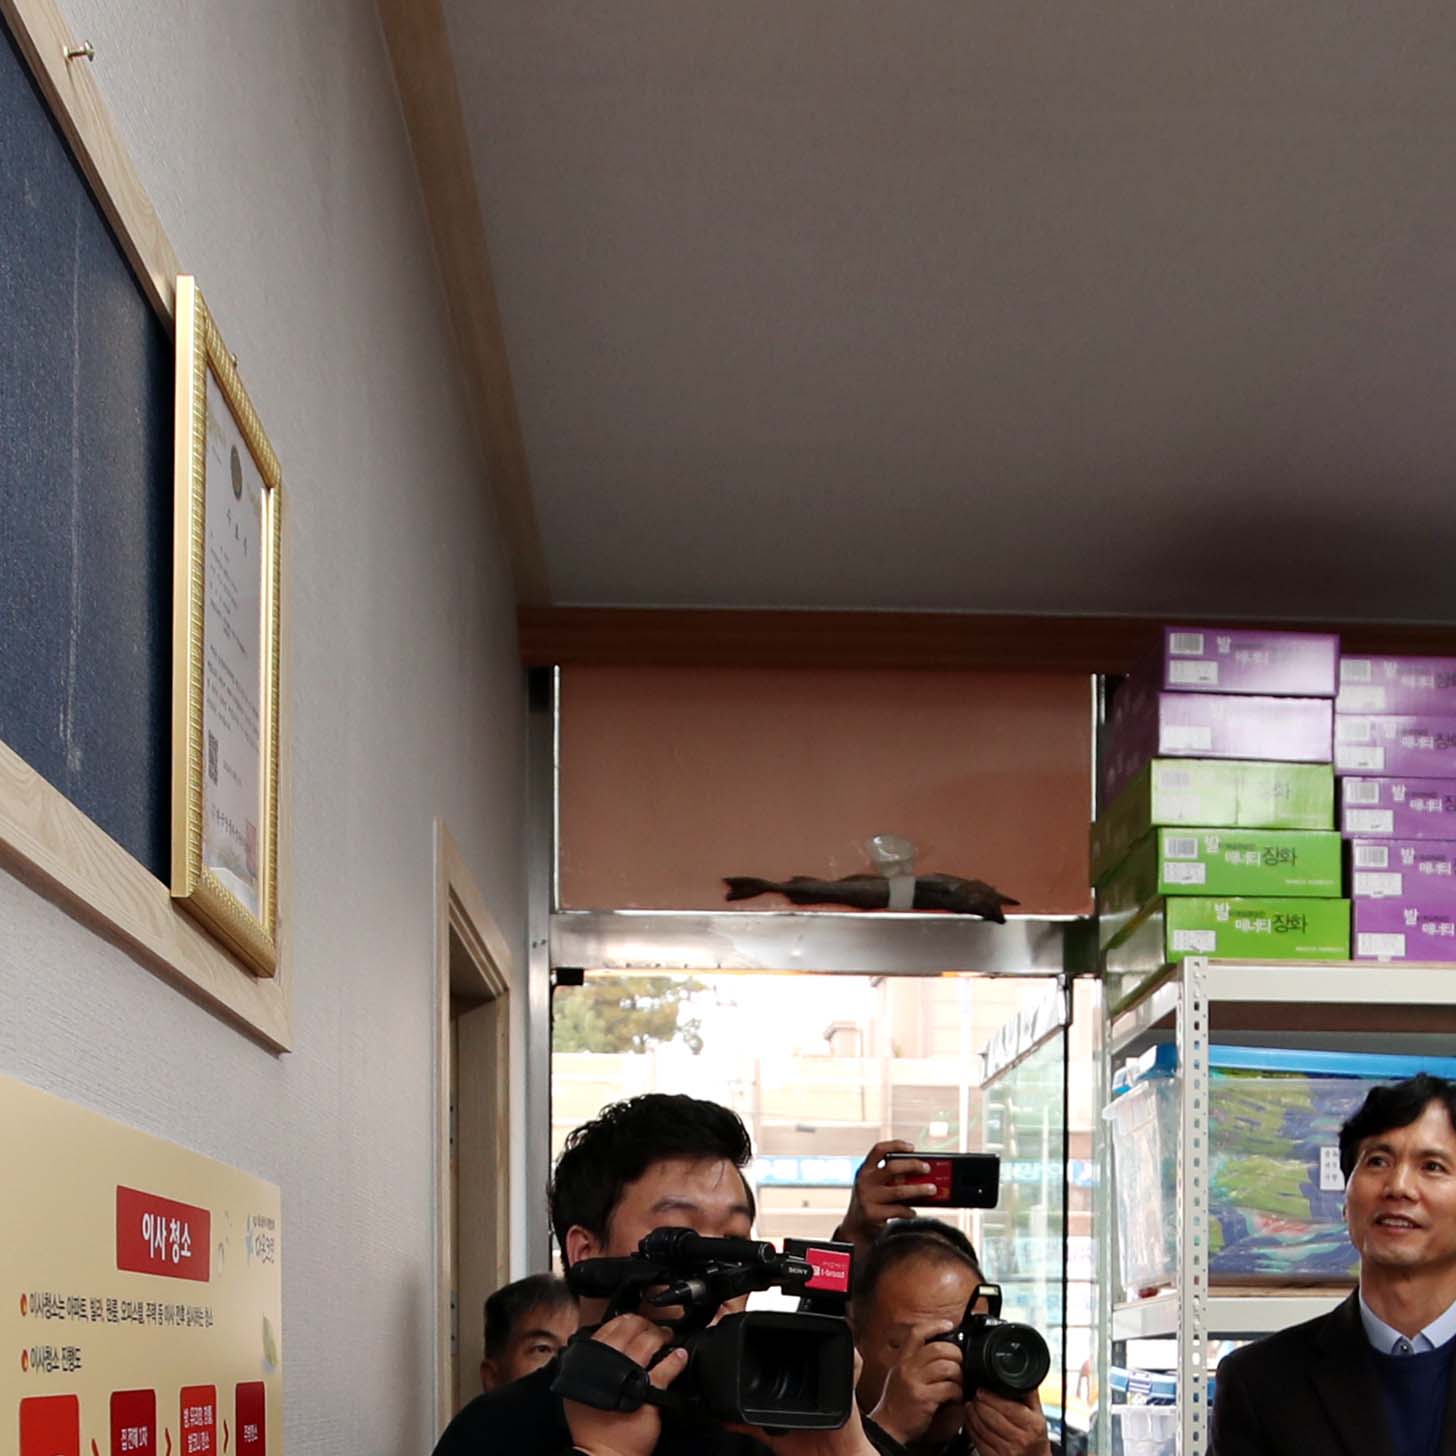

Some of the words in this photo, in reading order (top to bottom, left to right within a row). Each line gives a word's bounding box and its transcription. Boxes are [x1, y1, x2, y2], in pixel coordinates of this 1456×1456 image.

[1262, 847, 1297, 867] 장화
[1273, 912, 1308, 934] 장화
[142, 1210, 167, 1262] 이사
[168, 1215, 191, 1268] 청소
[788, 1266, 808, 1276] SONY
